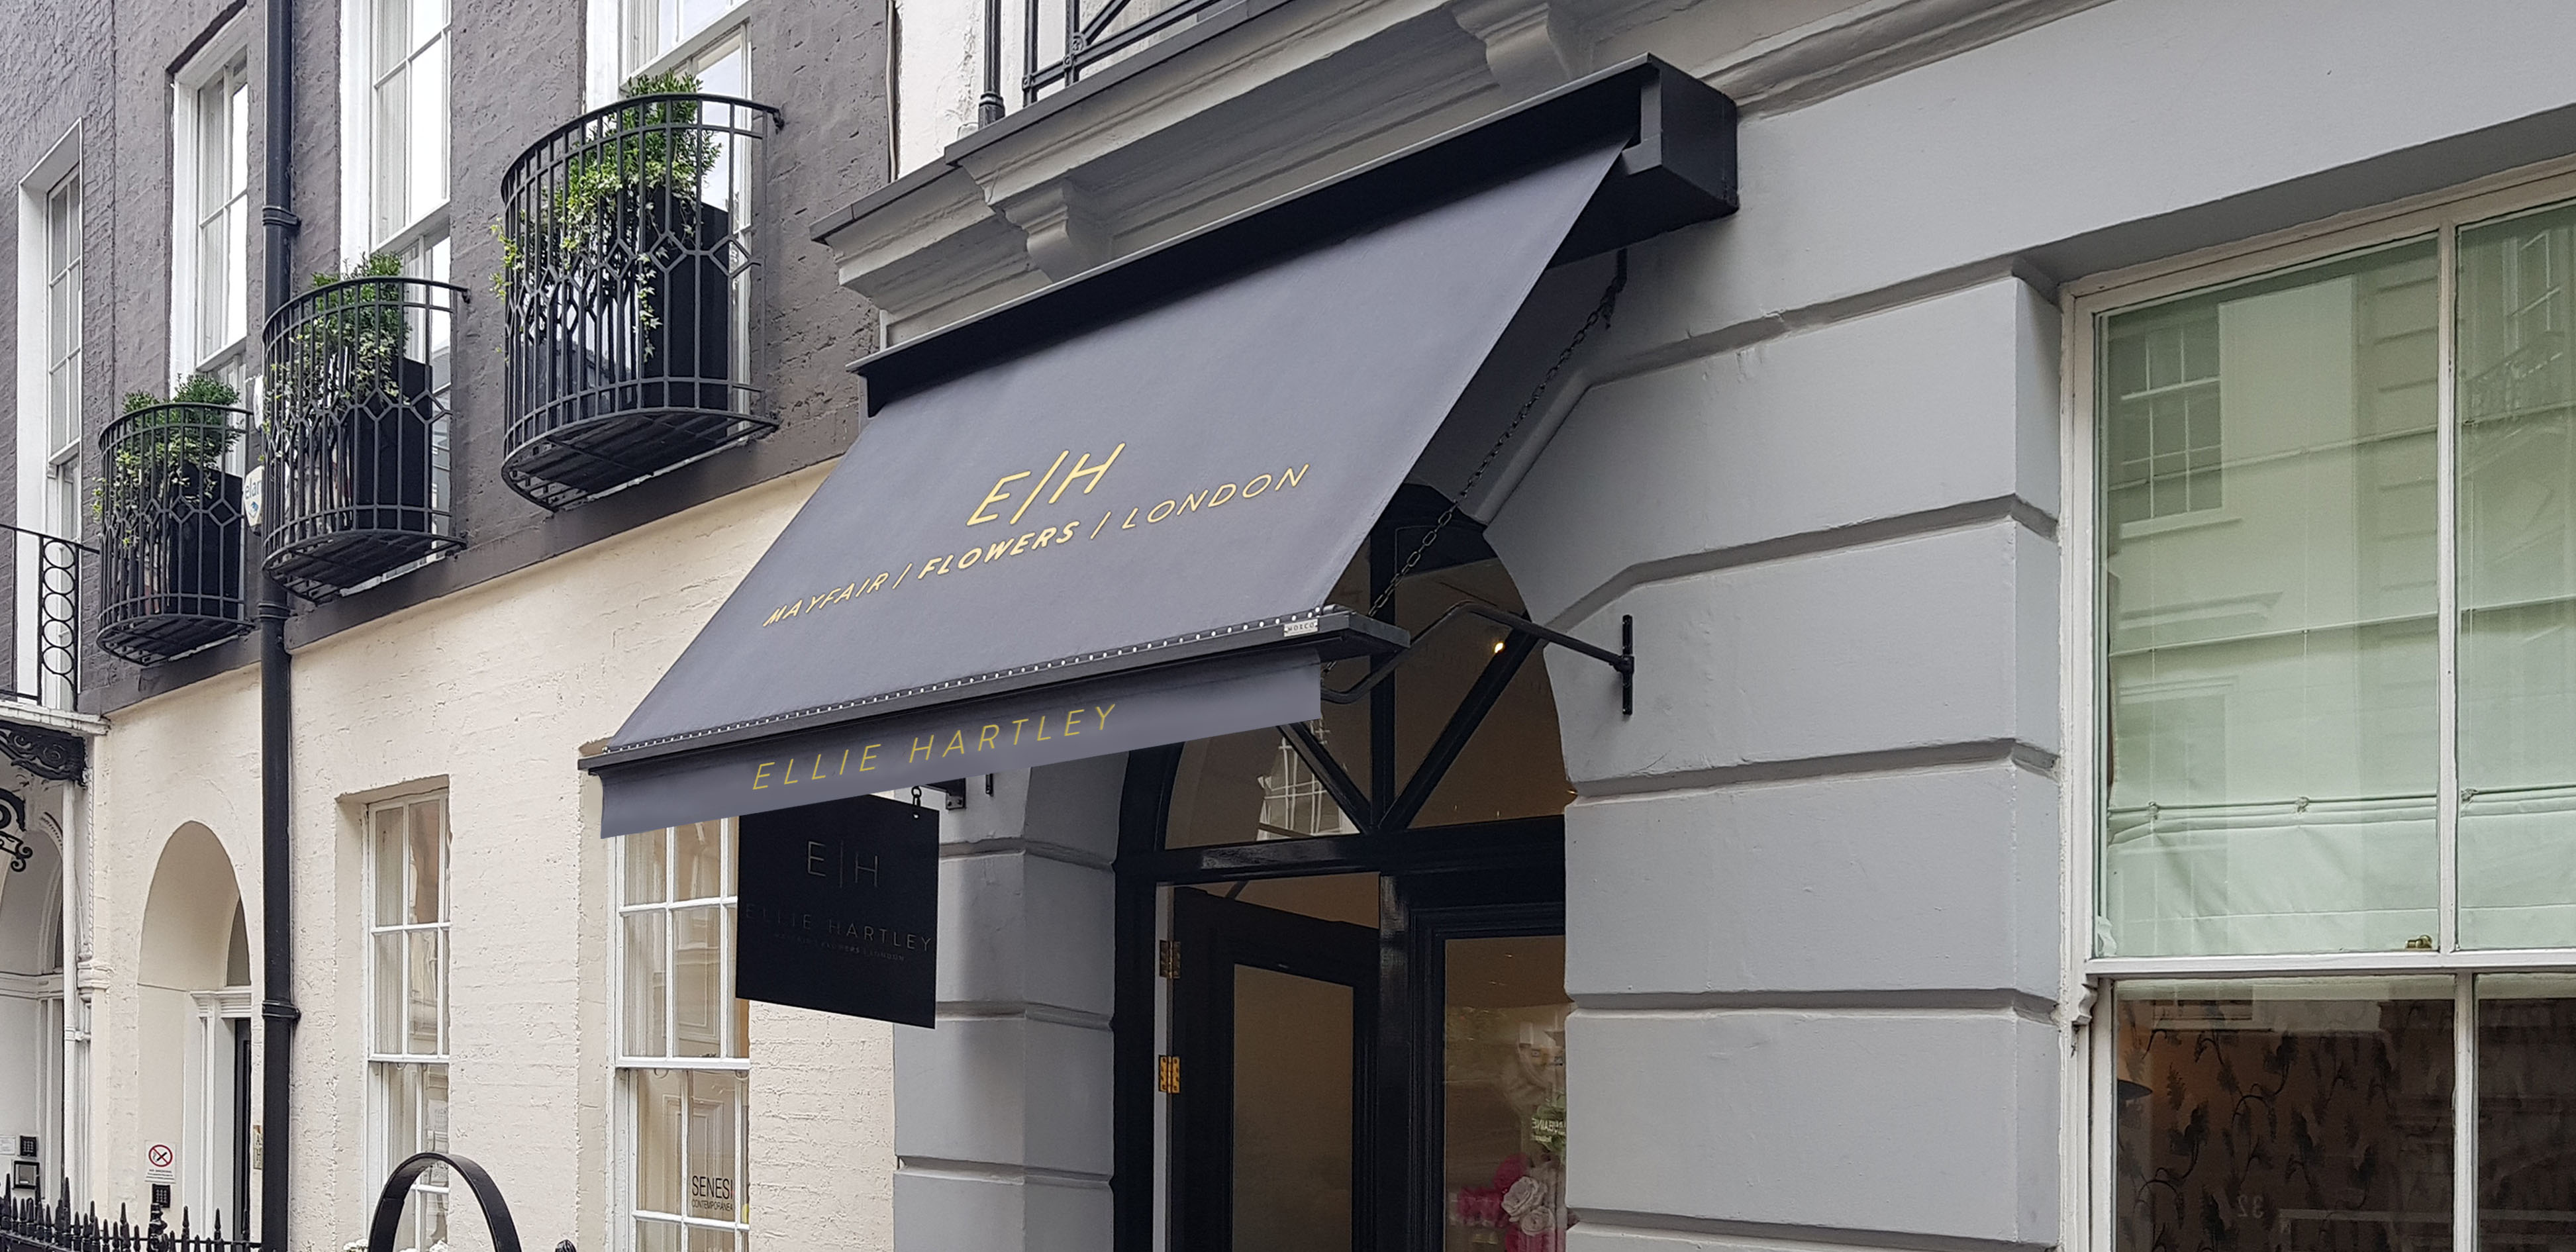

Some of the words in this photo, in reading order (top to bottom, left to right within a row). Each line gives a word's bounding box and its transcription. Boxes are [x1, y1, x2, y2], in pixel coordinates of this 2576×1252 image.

[762, 572, 889, 626] MAYFAIR
[918, 521, 1080, 579] FLOWERS
[1122, 463, 1311, 529] LONDON
[752, 744, 881, 791] ELLIE
[909, 704, 1115, 763] HARTLEY
[828, 919, 932, 951] HARTLEY
[692, 1175, 733, 1200] SENESI
